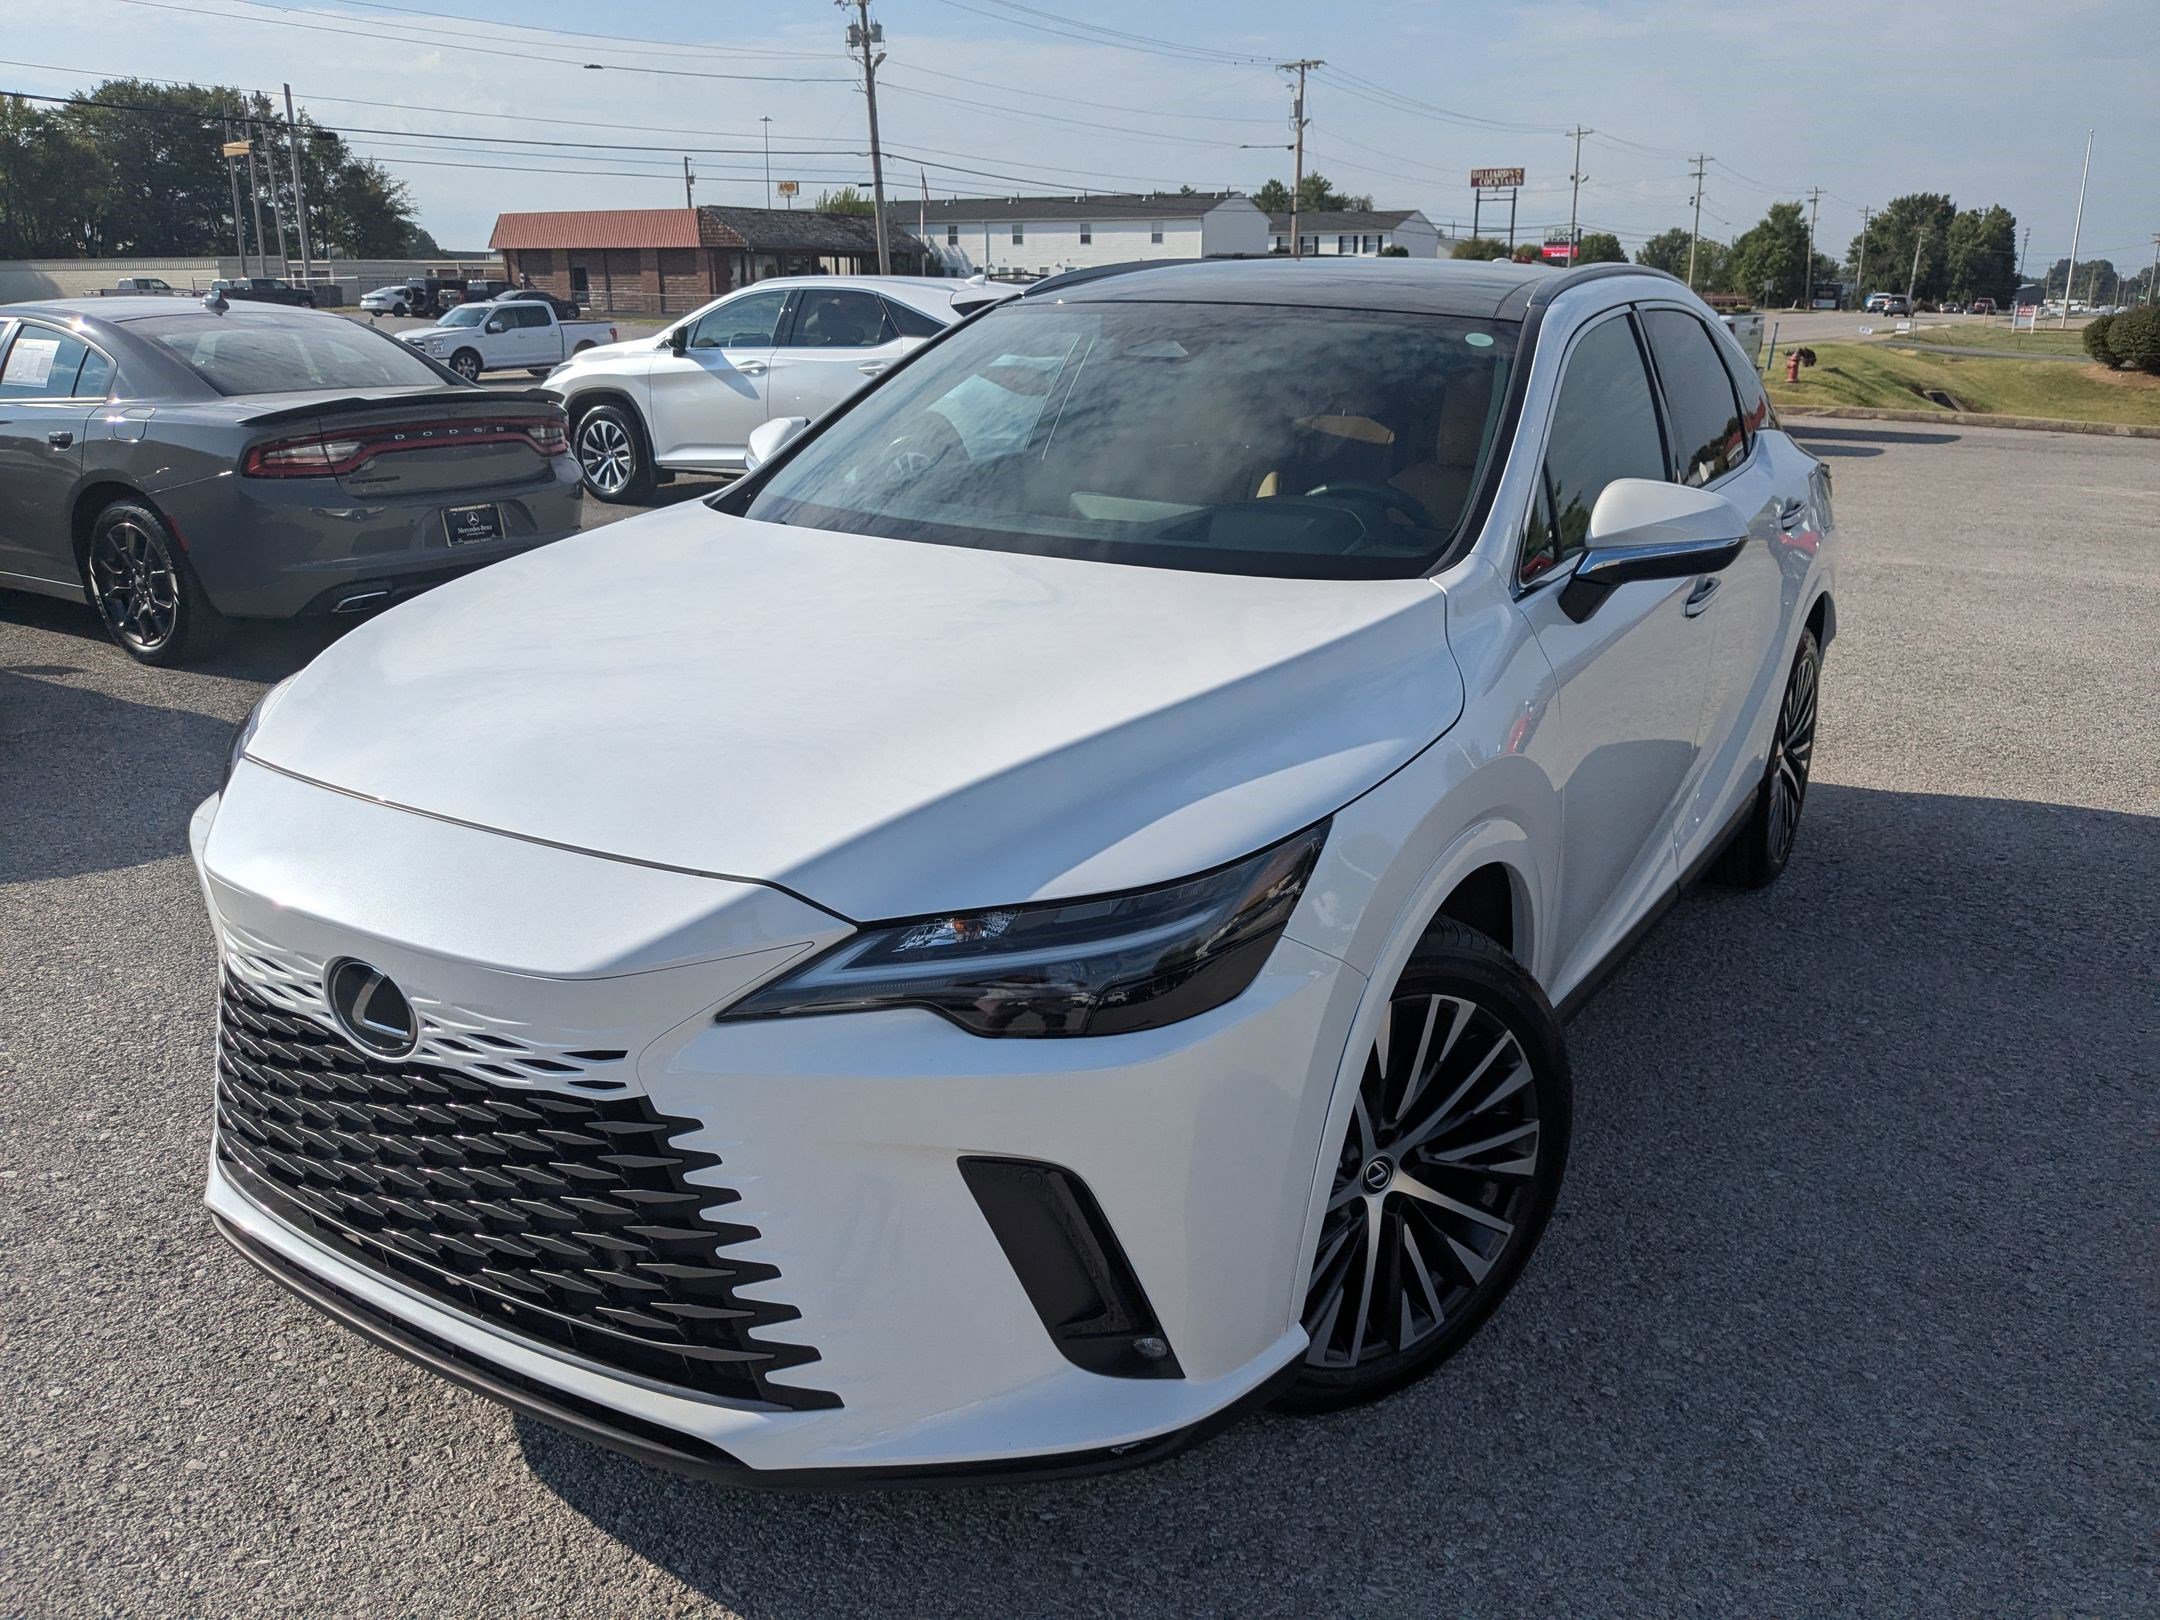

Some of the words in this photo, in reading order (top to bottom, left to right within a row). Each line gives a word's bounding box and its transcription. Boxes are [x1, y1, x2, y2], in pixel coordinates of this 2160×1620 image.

[1472, 169, 1514, 178] BILLIARDS
[1479, 177, 1521, 185] COCKTAILS
[394, 426, 505, 440] DODGE
[457, 524, 493, 534] Mercedes-Benz
